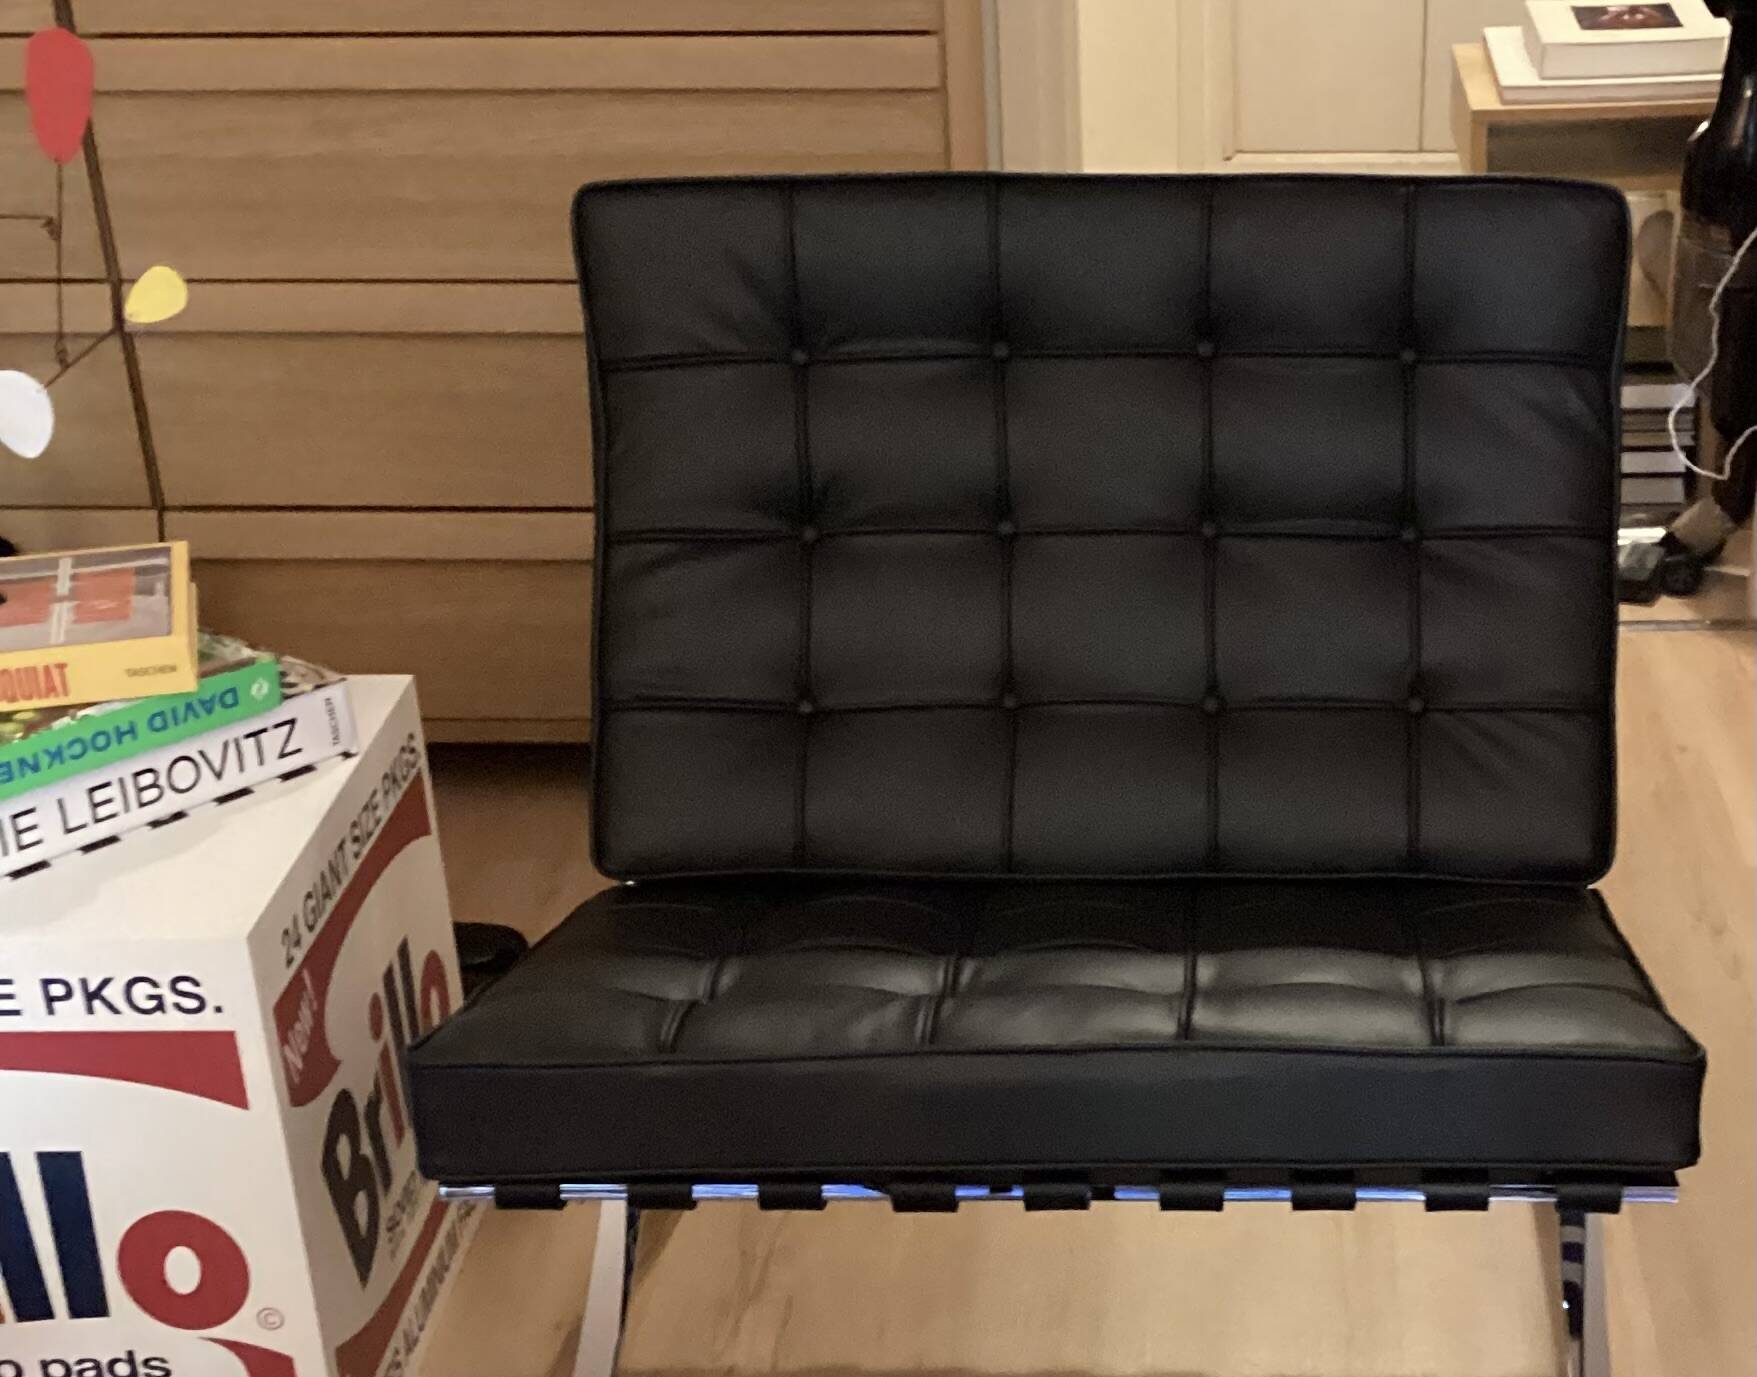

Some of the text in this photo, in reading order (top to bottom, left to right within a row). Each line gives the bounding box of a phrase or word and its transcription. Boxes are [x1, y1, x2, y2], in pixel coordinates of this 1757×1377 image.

[148, 686, 240, 732] DAVID
[57, 717, 304, 835] LEIBOVITZ
[281, 913, 302, 969] 24
[303, 837, 350, 934] GIANT
[351, 788, 382, 860] SIZE
[40, 975, 223, 1016] PKGS.
